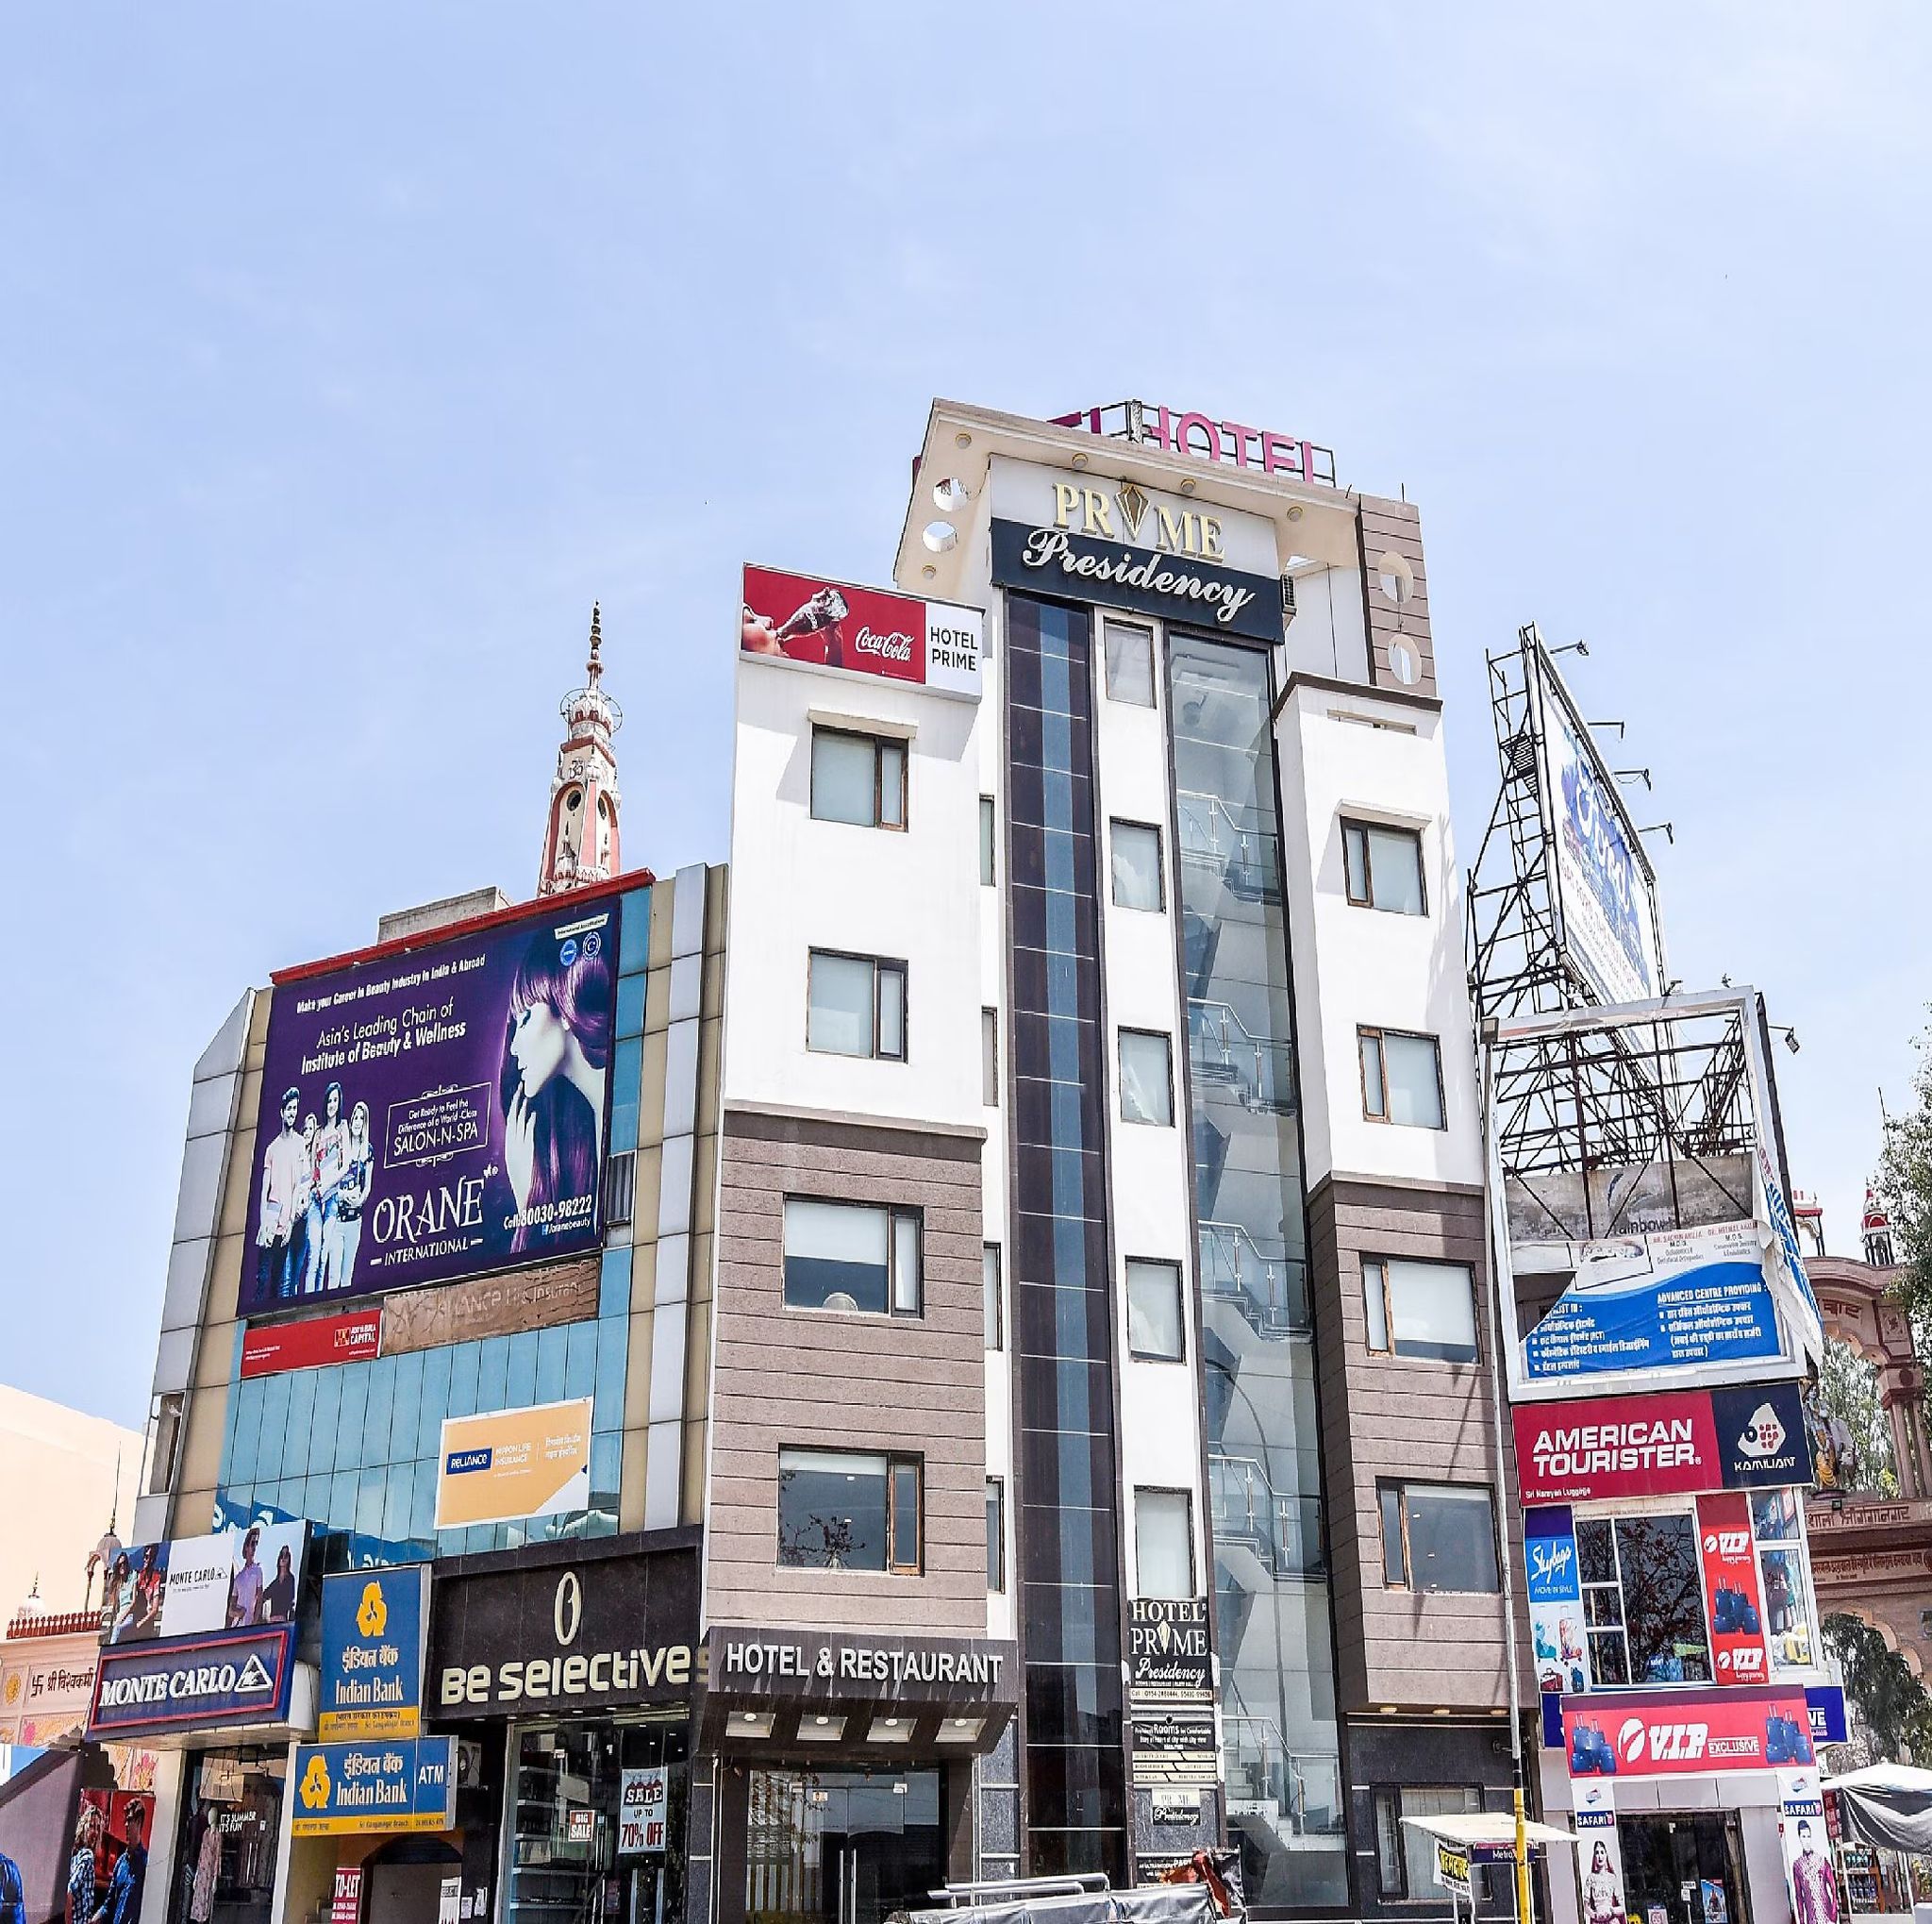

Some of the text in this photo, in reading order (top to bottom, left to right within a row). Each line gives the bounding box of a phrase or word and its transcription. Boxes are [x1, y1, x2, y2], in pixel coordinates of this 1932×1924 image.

[1022, 528, 1257, 623] Presidency
[930, 626, 978, 650] HOTEL
[931, 649, 977, 672] PRIME
[297, 1000, 315, 1013] Make
[316, 997, 332, 1012] your
[333, 991, 357, 1006] Career
[366, 979, 391, 996] Beauty
[391, 973, 421, 992] Industry
[431, 964, 449, 979] India
[451, 962, 458, 974] &
[458, 954, 486, 972] Abroad
[317, 996, 454, 1048] Asia's Leading Chain of
[301, 1022, 466, 1075] Institute of Beauty & Wellness
[409, 1097, 468, 1120] Get Ready to Feel the
[398, 1121, 426, 1135] Difference
[441, 1112, 458, 1124] World
[394, 1121, 478, 1157] SALON-N-SPA
[373, 1176, 485, 1244] ORANE
[384, 1238, 469, 1266] INTERNATIONAL
[1657, 1282, 1762, 1304] ADVANCED CENTRE PROVIDING
[350, 1331, 375, 1345] CAPITAL
[1533, 1417, 1692, 1454] AMERICAN
[1733, 1456, 1795, 1472] KAMILIANT
[1525, 1489, 1535, 1499] Sri
[1562, 1485, 1591, 1498] Luggage
[1531, 1540, 1572, 1584] Skybags
[169, 1568, 215, 1586] MONTE CARLO
[1132, 1601, 1206, 1622] HOTEL
[341, 1645, 399, 1674] इंडियन बैंक
[726, 1642, 1004, 1684] HOTEL & RESTAURANT
[47, 1670, 57, 1692] श्री
[1135, 1657, 1206, 1688] Presidency
[98, 1664, 236, 1707] MONTE CARLO
[336, 1674, 404, 1705] Indian Bank
[441, 1665, 491, 1705] Be
[1154, 1724, 1179, 1734] Rooms
[1708, 1739, 1760, 1755] EXCLUSIVE
[343, 1752, 403, 1780] इंडियन बैंक
[336, 1765, 444, 1806] Indian Bank ATM
[625, 1787, 663, 1804] SALE
[220, 1812, 257, 1824] IT'S SUMMER
[575, 1813, 589, 1823] BIG
[634, 1809, 653, 1819] UP TO
[1784, 1803, 1815, 1815] SAFARI
[219, 1821, 242, 1832] IT'S FUN
[571, 1824, 591, 1838] SALE
[1577, 1815, 1607, 1827] SAFARI
[622, 1822, 664, 1848] 70% OFF
[335, 1874, 360, 1898] TO-LET
